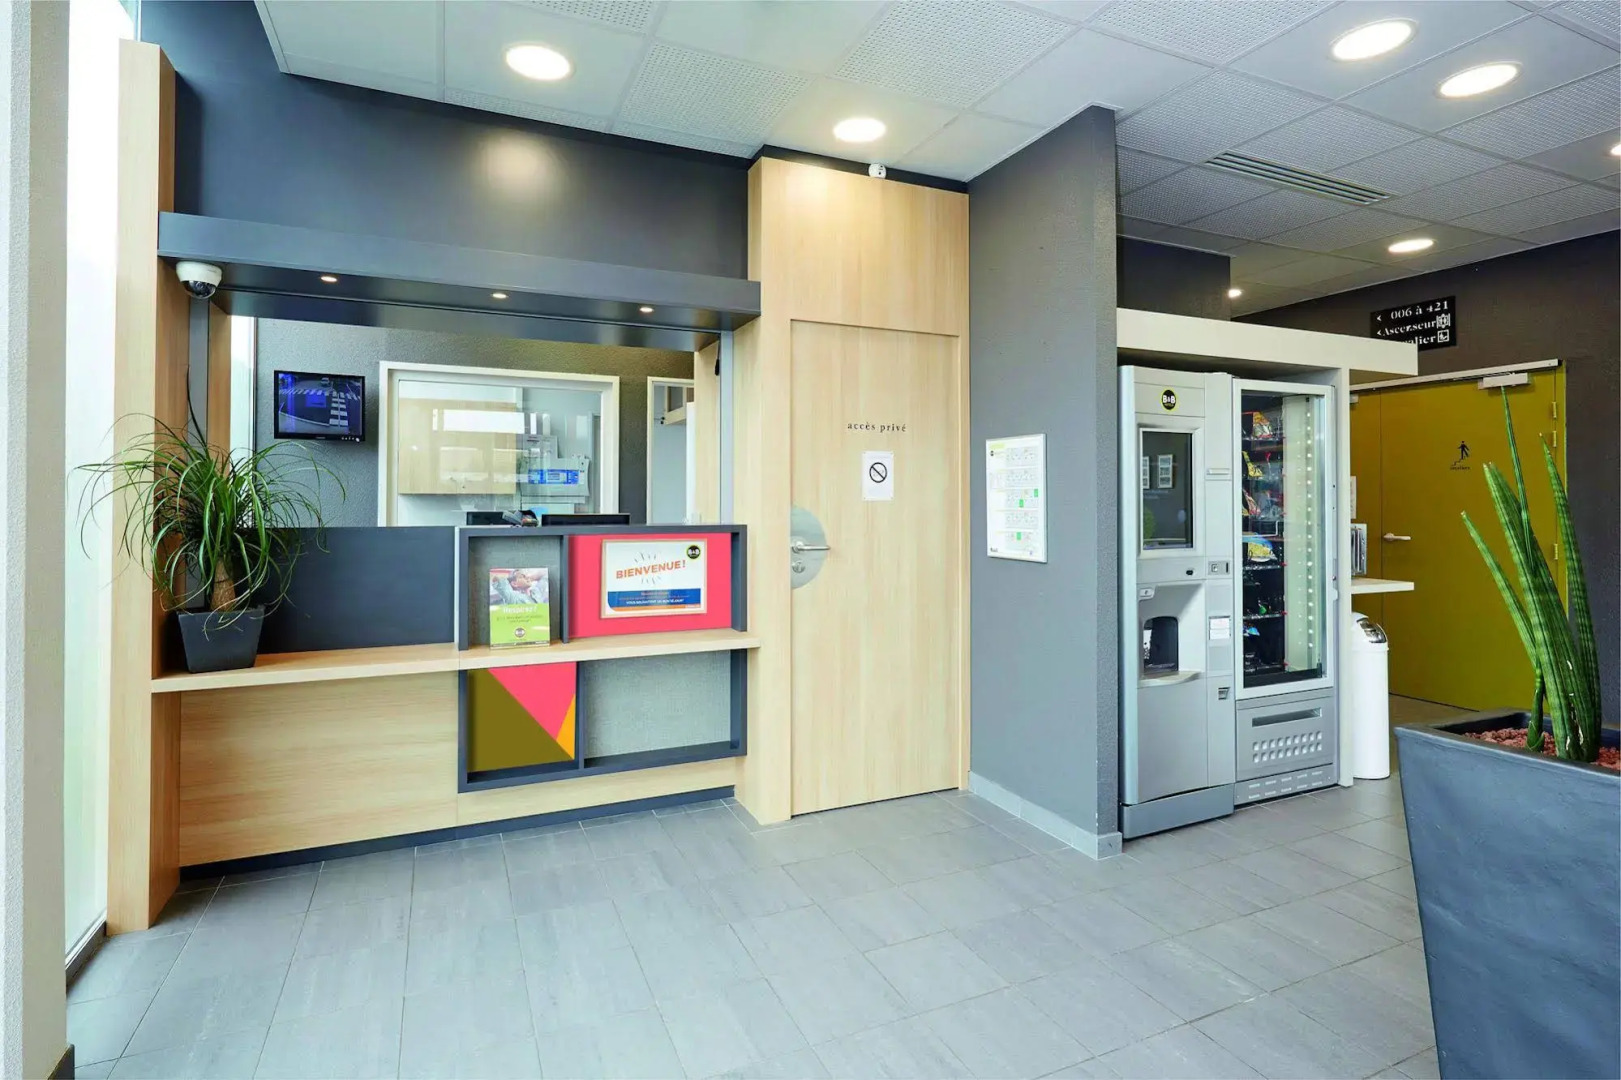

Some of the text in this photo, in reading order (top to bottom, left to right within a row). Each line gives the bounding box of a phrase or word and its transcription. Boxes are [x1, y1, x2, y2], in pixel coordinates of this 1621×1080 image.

[1391, 300, 1449, 319] 006 à 421
[847, 421, 907, 433] accès privé
